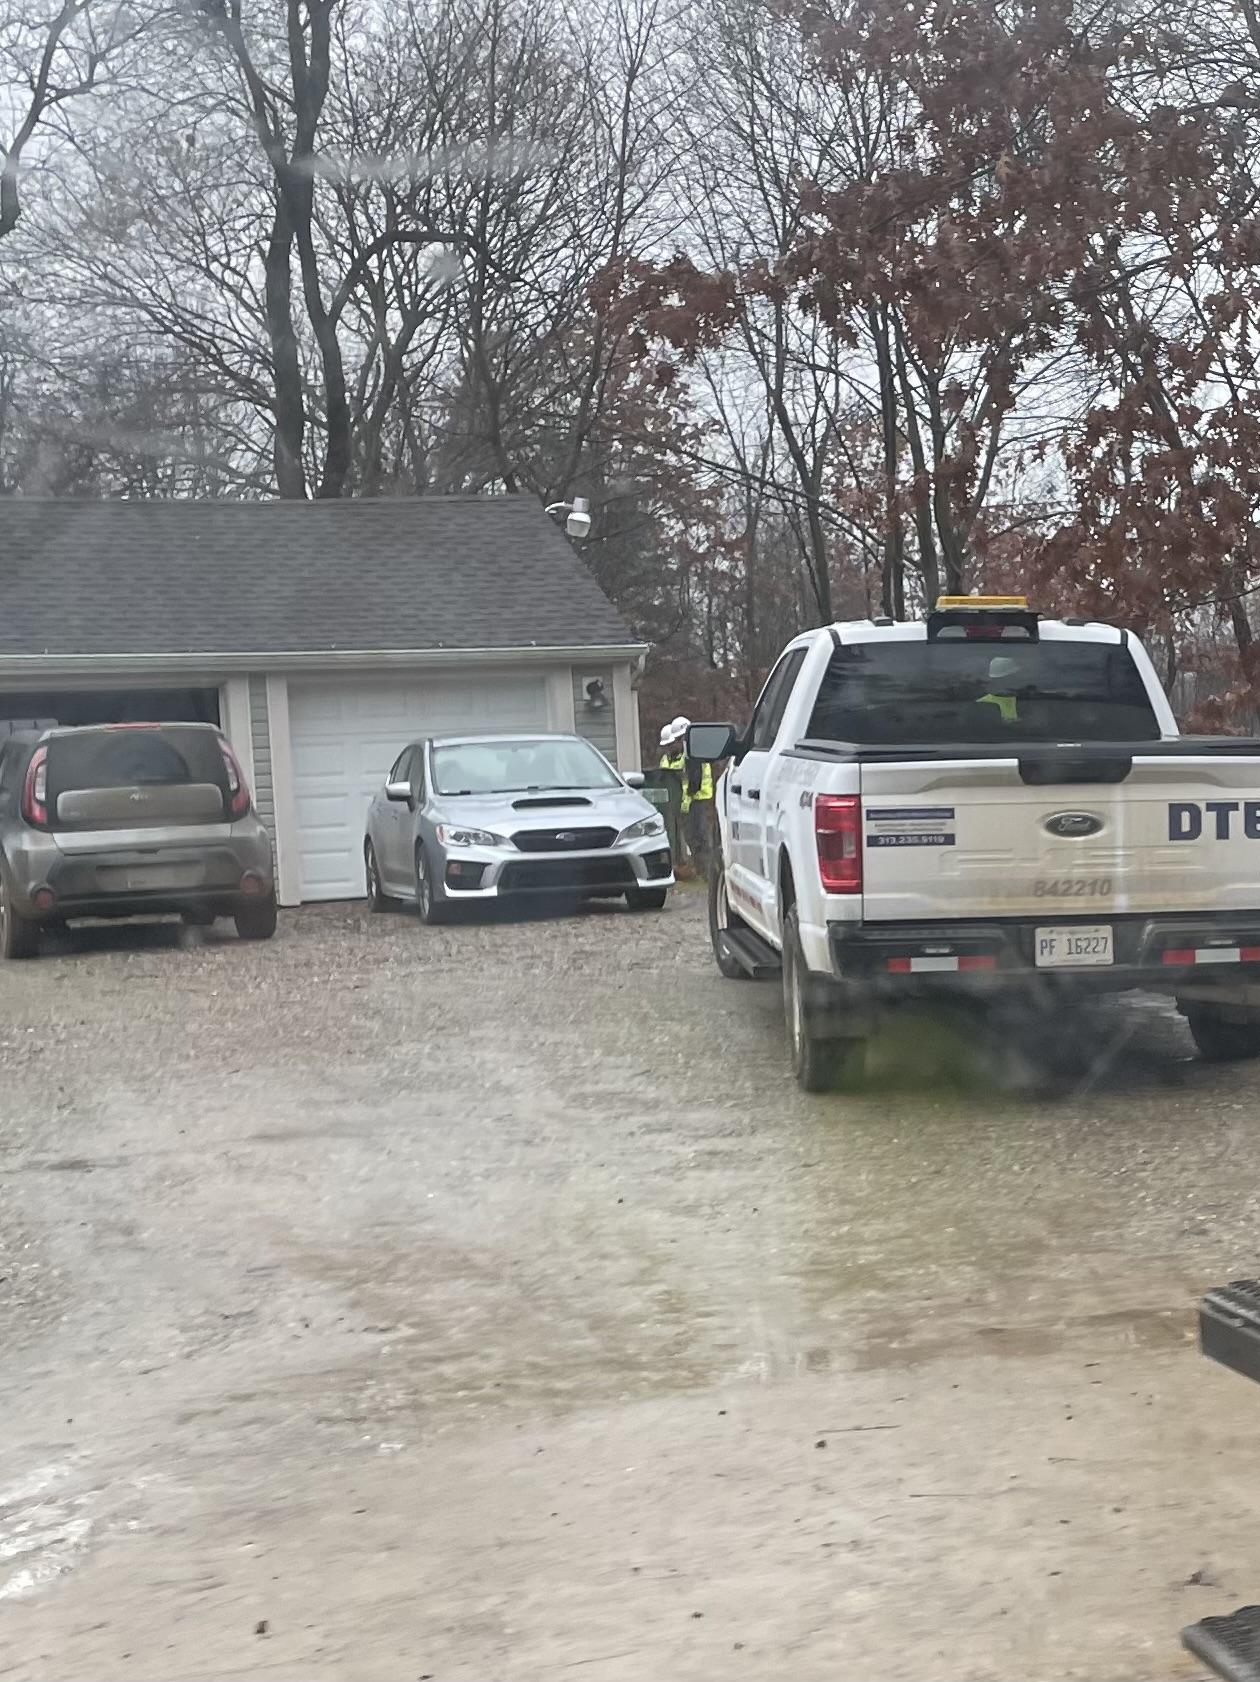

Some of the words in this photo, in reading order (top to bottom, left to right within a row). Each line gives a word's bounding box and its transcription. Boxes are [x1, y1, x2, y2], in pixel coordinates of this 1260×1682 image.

[1033, 879, 1112, 897] 842210
[1040, 938, 1056, 957] PF
[1066, 936, 1108, 956] 16227
